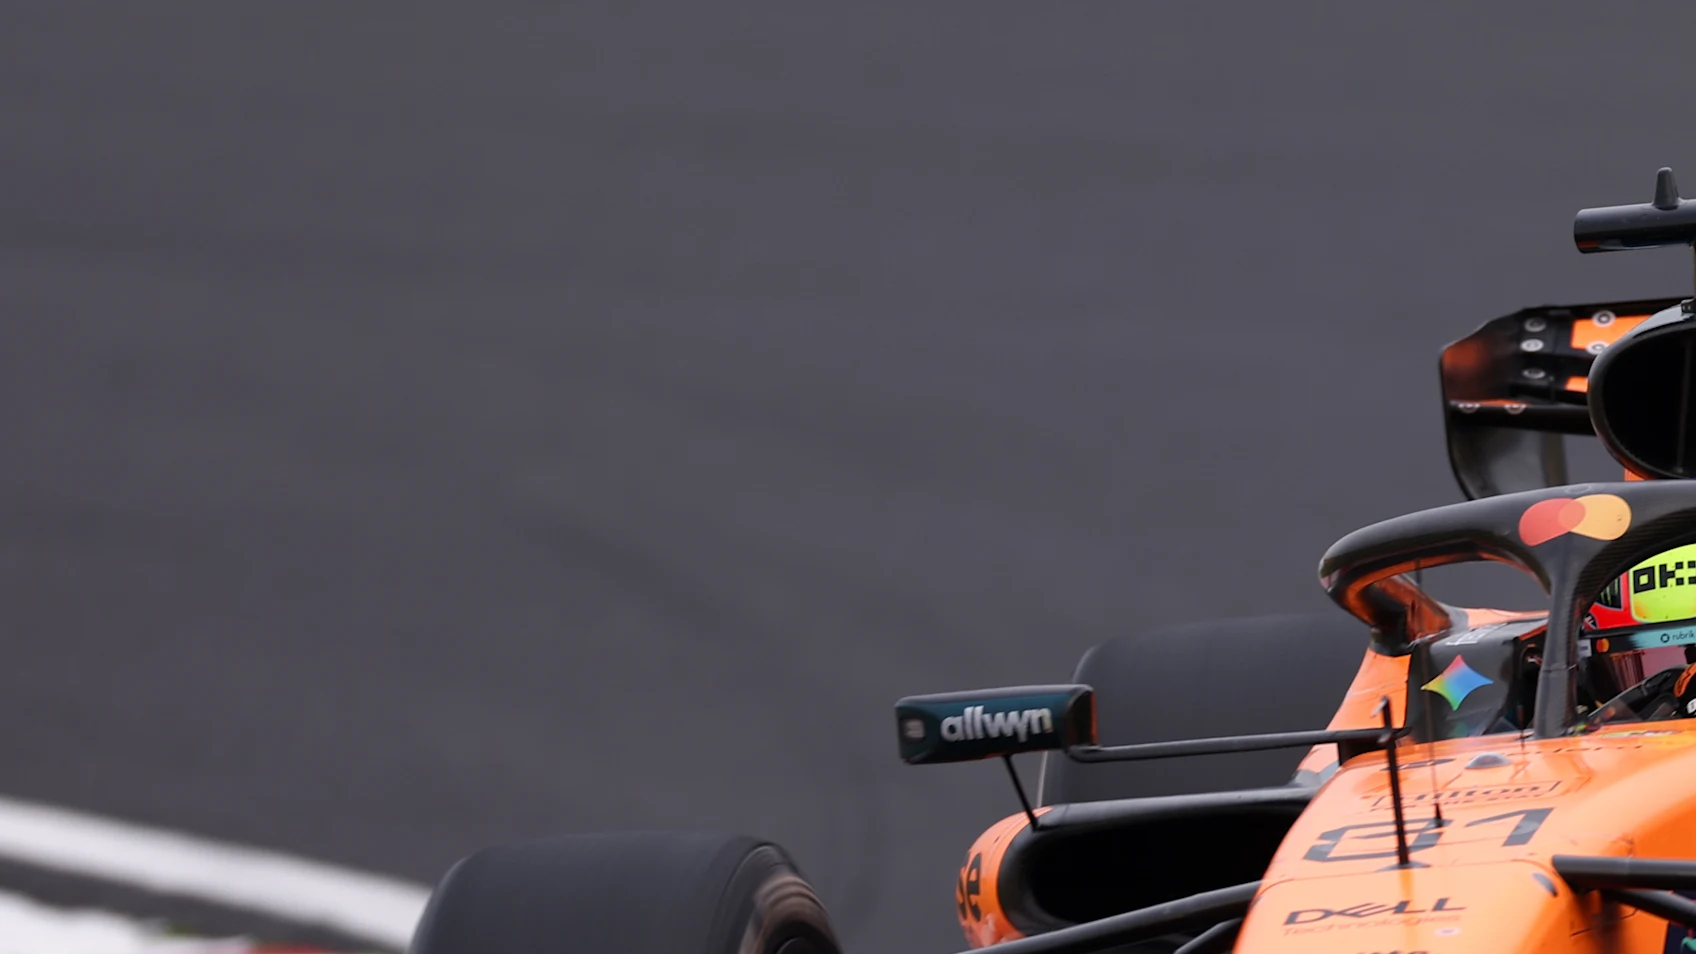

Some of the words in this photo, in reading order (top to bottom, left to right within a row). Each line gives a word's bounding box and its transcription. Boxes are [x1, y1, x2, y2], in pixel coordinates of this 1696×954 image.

[1672, 629, 1695, 641] rubrik
[940, 705, 1053, 743] allwyn
[1303, 807, 1554, 863] 81
[1283, 897, 1467, 926] DELL
[1283, 914, 1462, 937] Technologies
